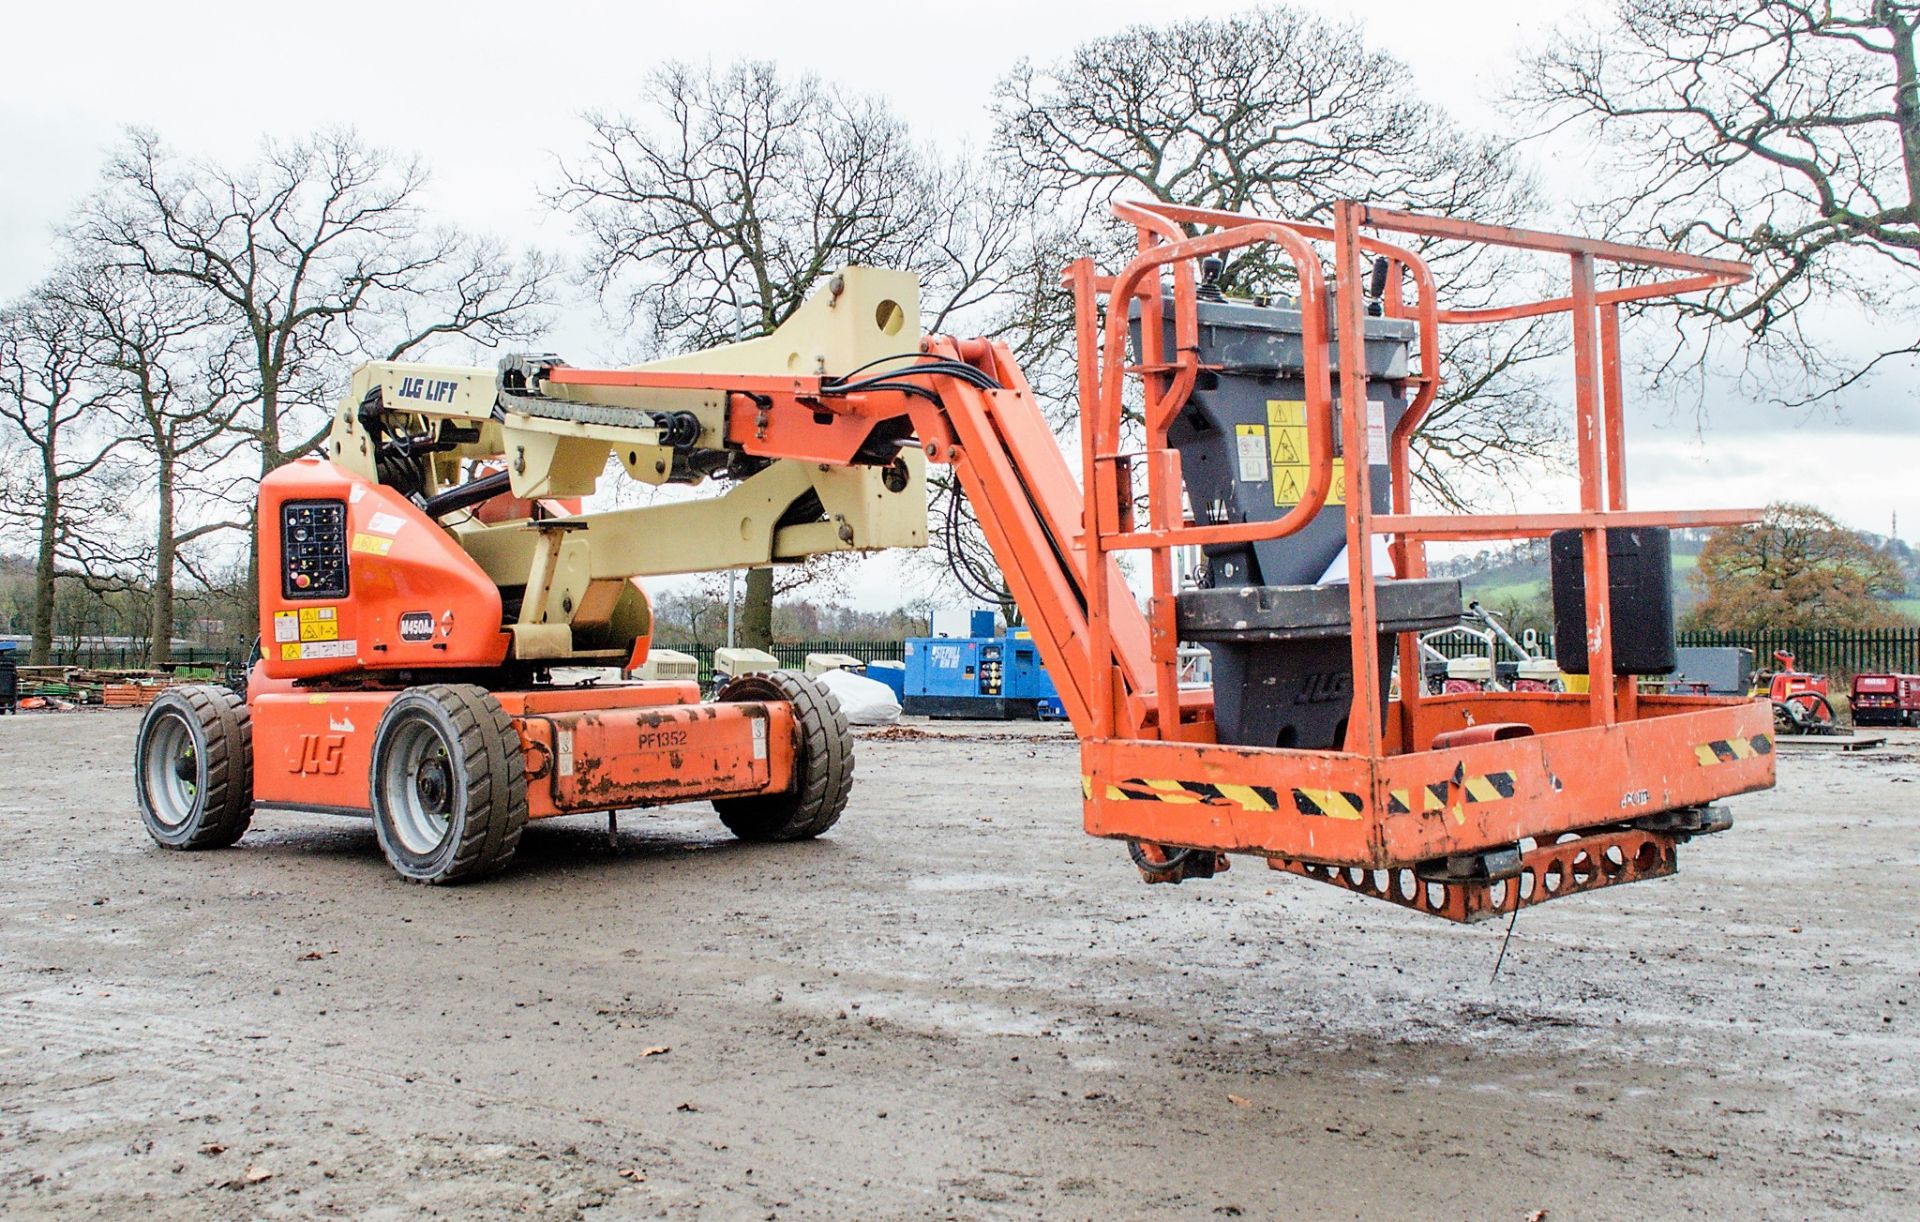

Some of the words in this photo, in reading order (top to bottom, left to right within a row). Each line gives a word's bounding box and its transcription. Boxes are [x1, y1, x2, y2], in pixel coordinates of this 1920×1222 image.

[398, 377, 424, 399] JLG
[425, 380, 458, 403] LIFT
[401, 619, 434, 635] M450AJ
[639, 730, 688, 749] PF1352
[287, 734, 346, 777] JLG
